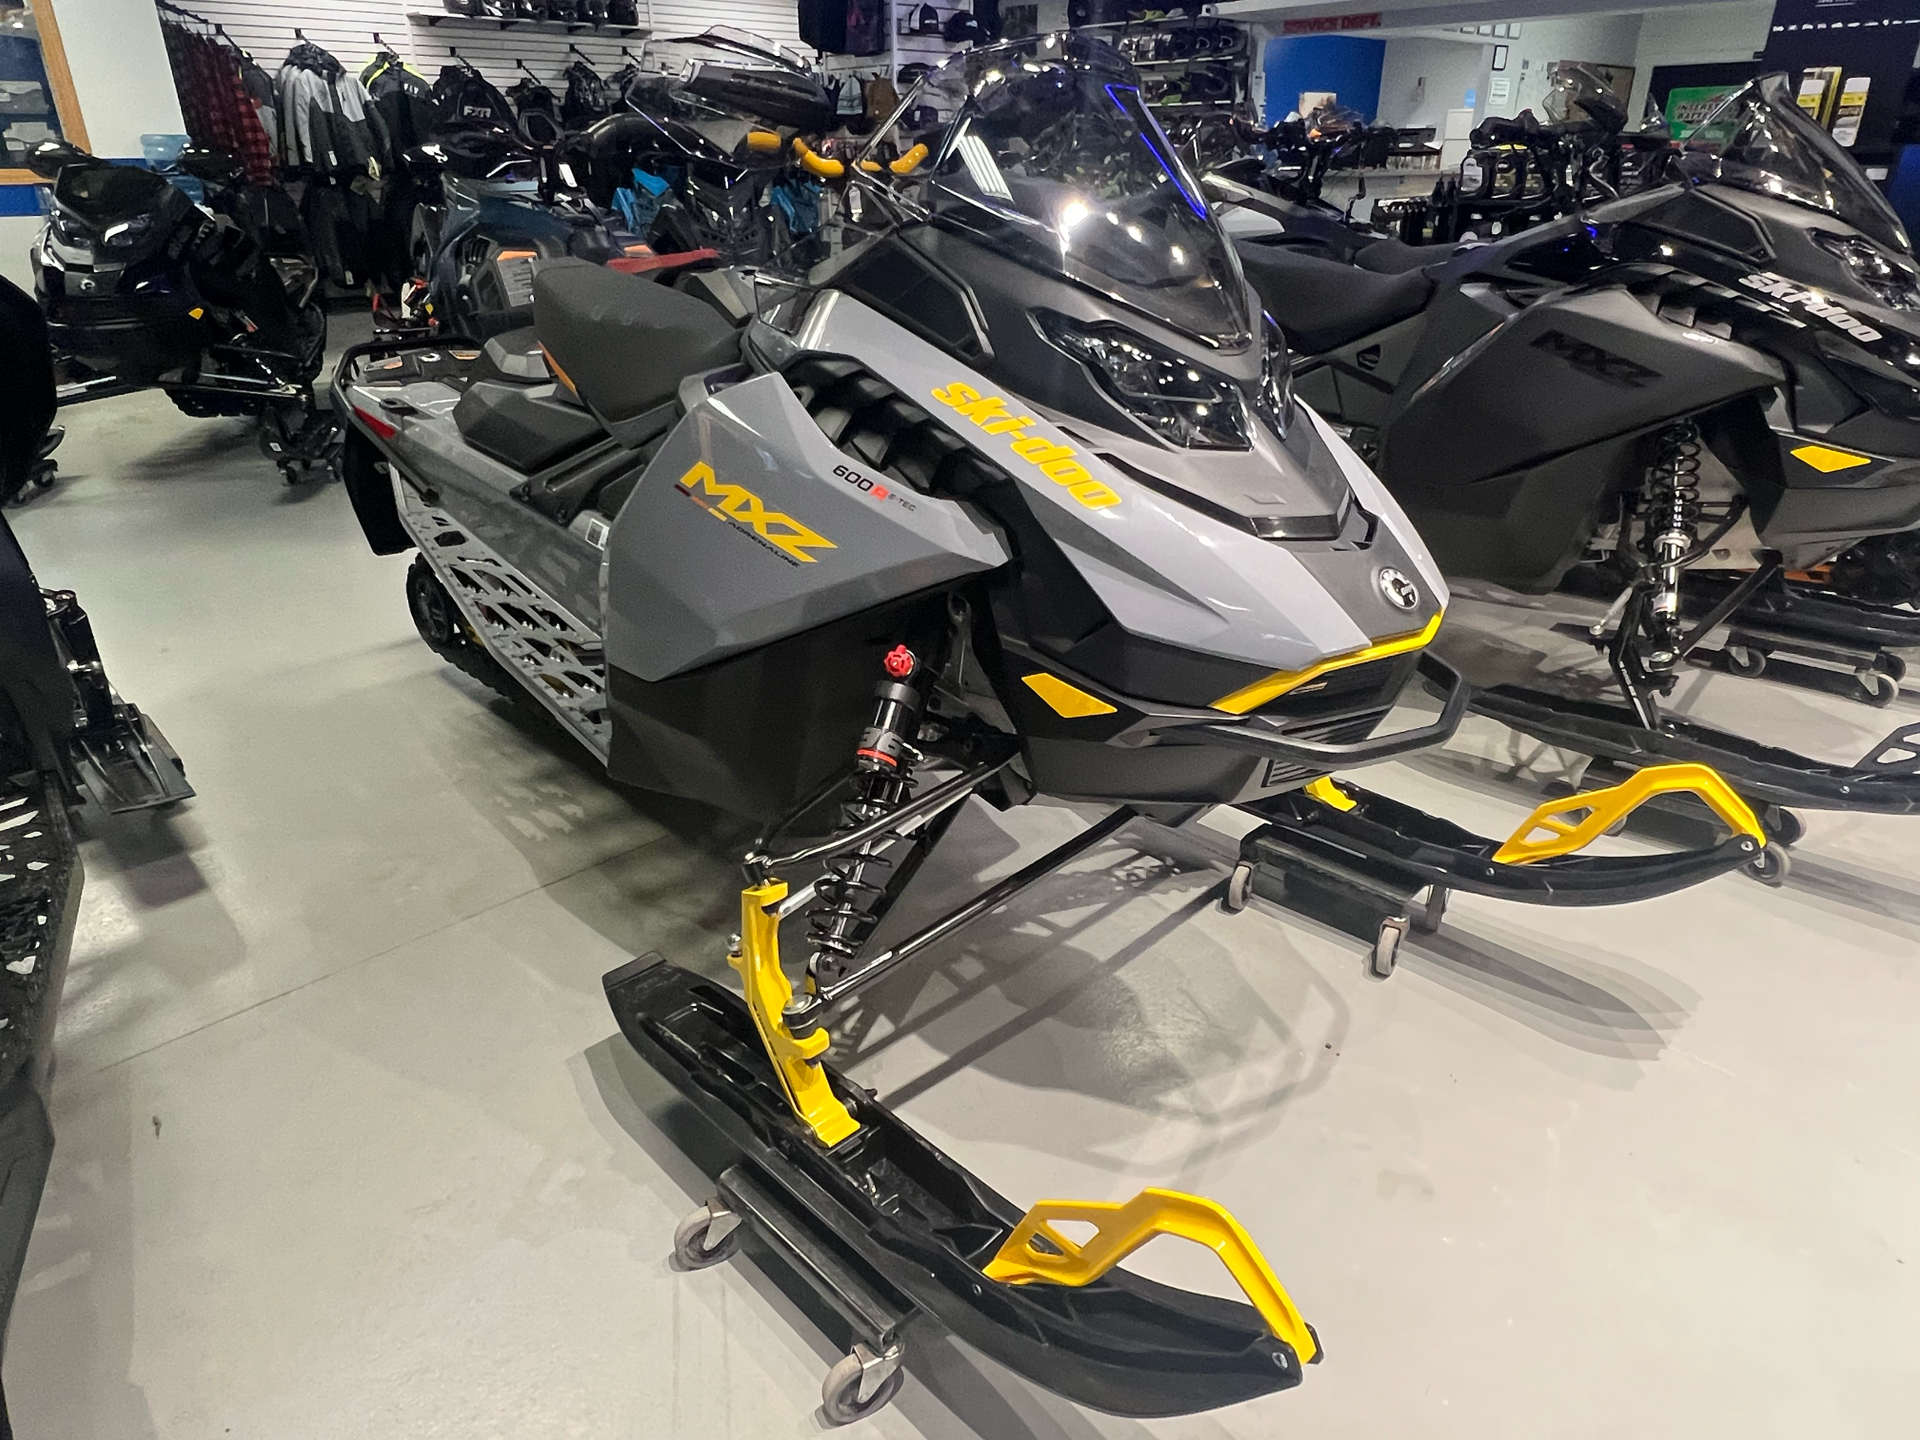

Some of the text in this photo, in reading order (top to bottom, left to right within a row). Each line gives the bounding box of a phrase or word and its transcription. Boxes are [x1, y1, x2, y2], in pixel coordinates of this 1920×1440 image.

[463, 105, 492, 118] FXR
[1529, 329, 1666, 389] MXZ
[930, 381, 1122, 510] ski-doo
[680, 461, 838, 563] MXZ
[727, 520, 800, 568] ADRENALINE
